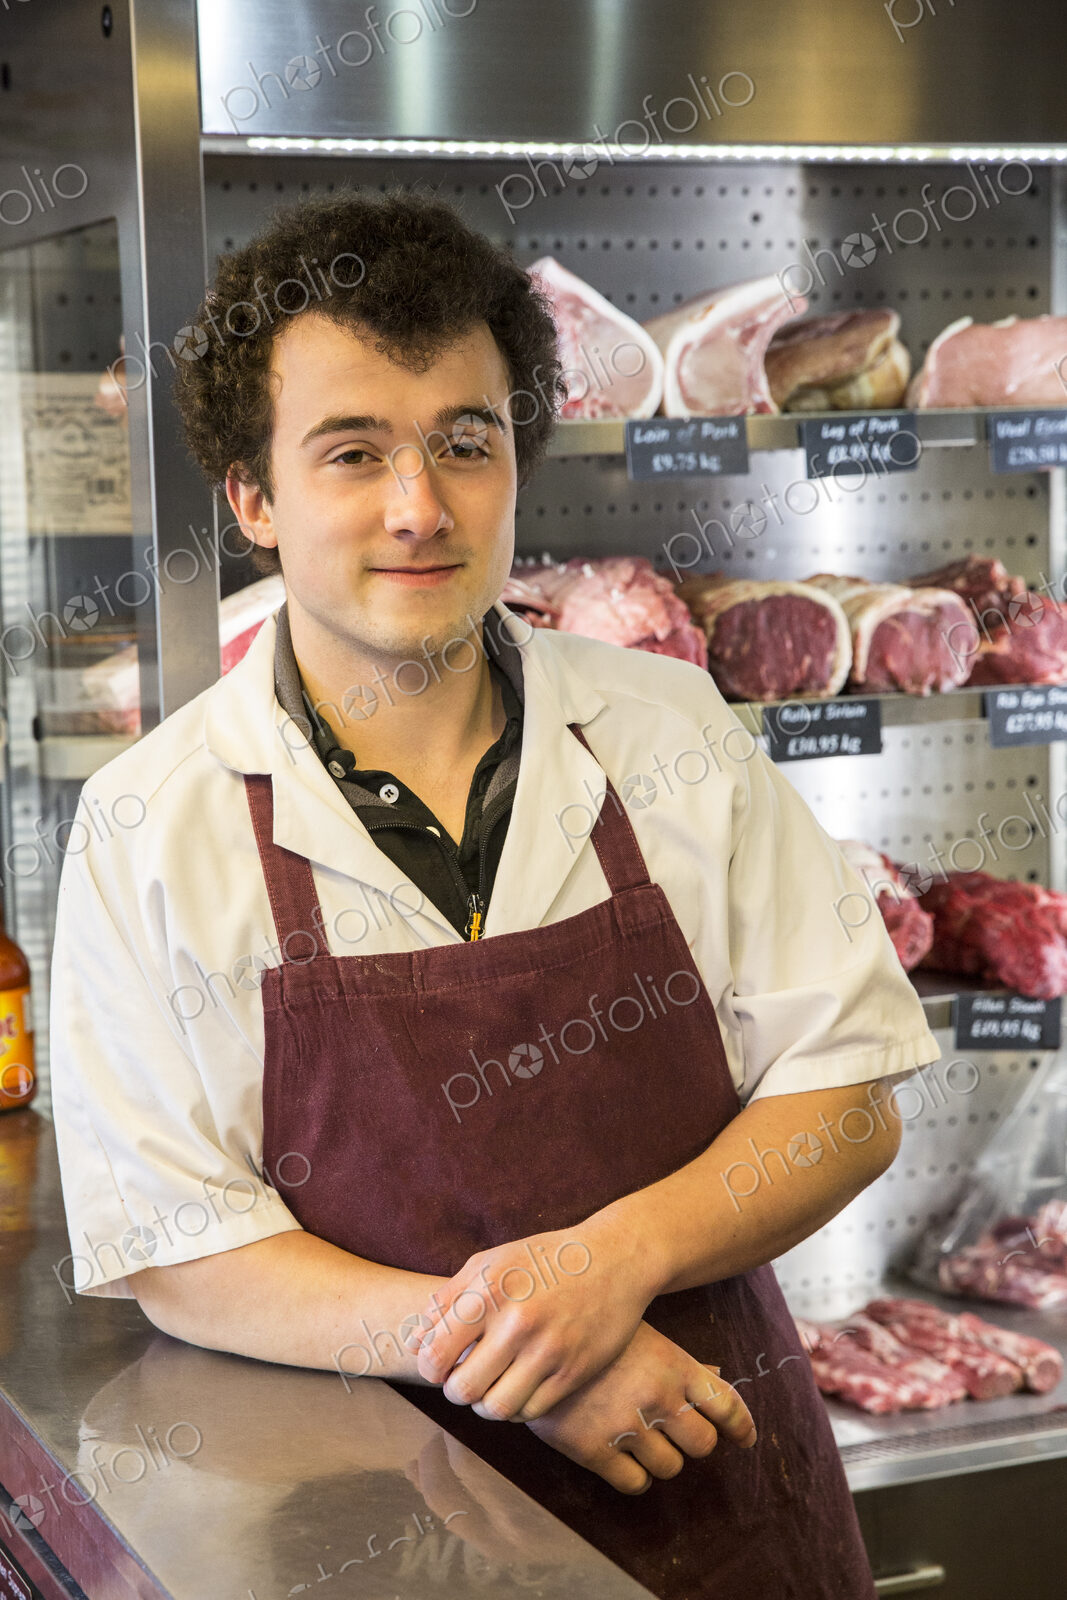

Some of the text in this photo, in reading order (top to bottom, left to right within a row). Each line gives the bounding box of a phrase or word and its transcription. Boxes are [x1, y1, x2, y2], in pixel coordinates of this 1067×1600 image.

[633, 422, 739, 444] Loin of Pork
[821, 417, 901, 441] Leg of Pork
[699, 452, 722, 472] kg
[840, 732, 862, 754] kg
[1021, 1019, 1042, 1042] kg
